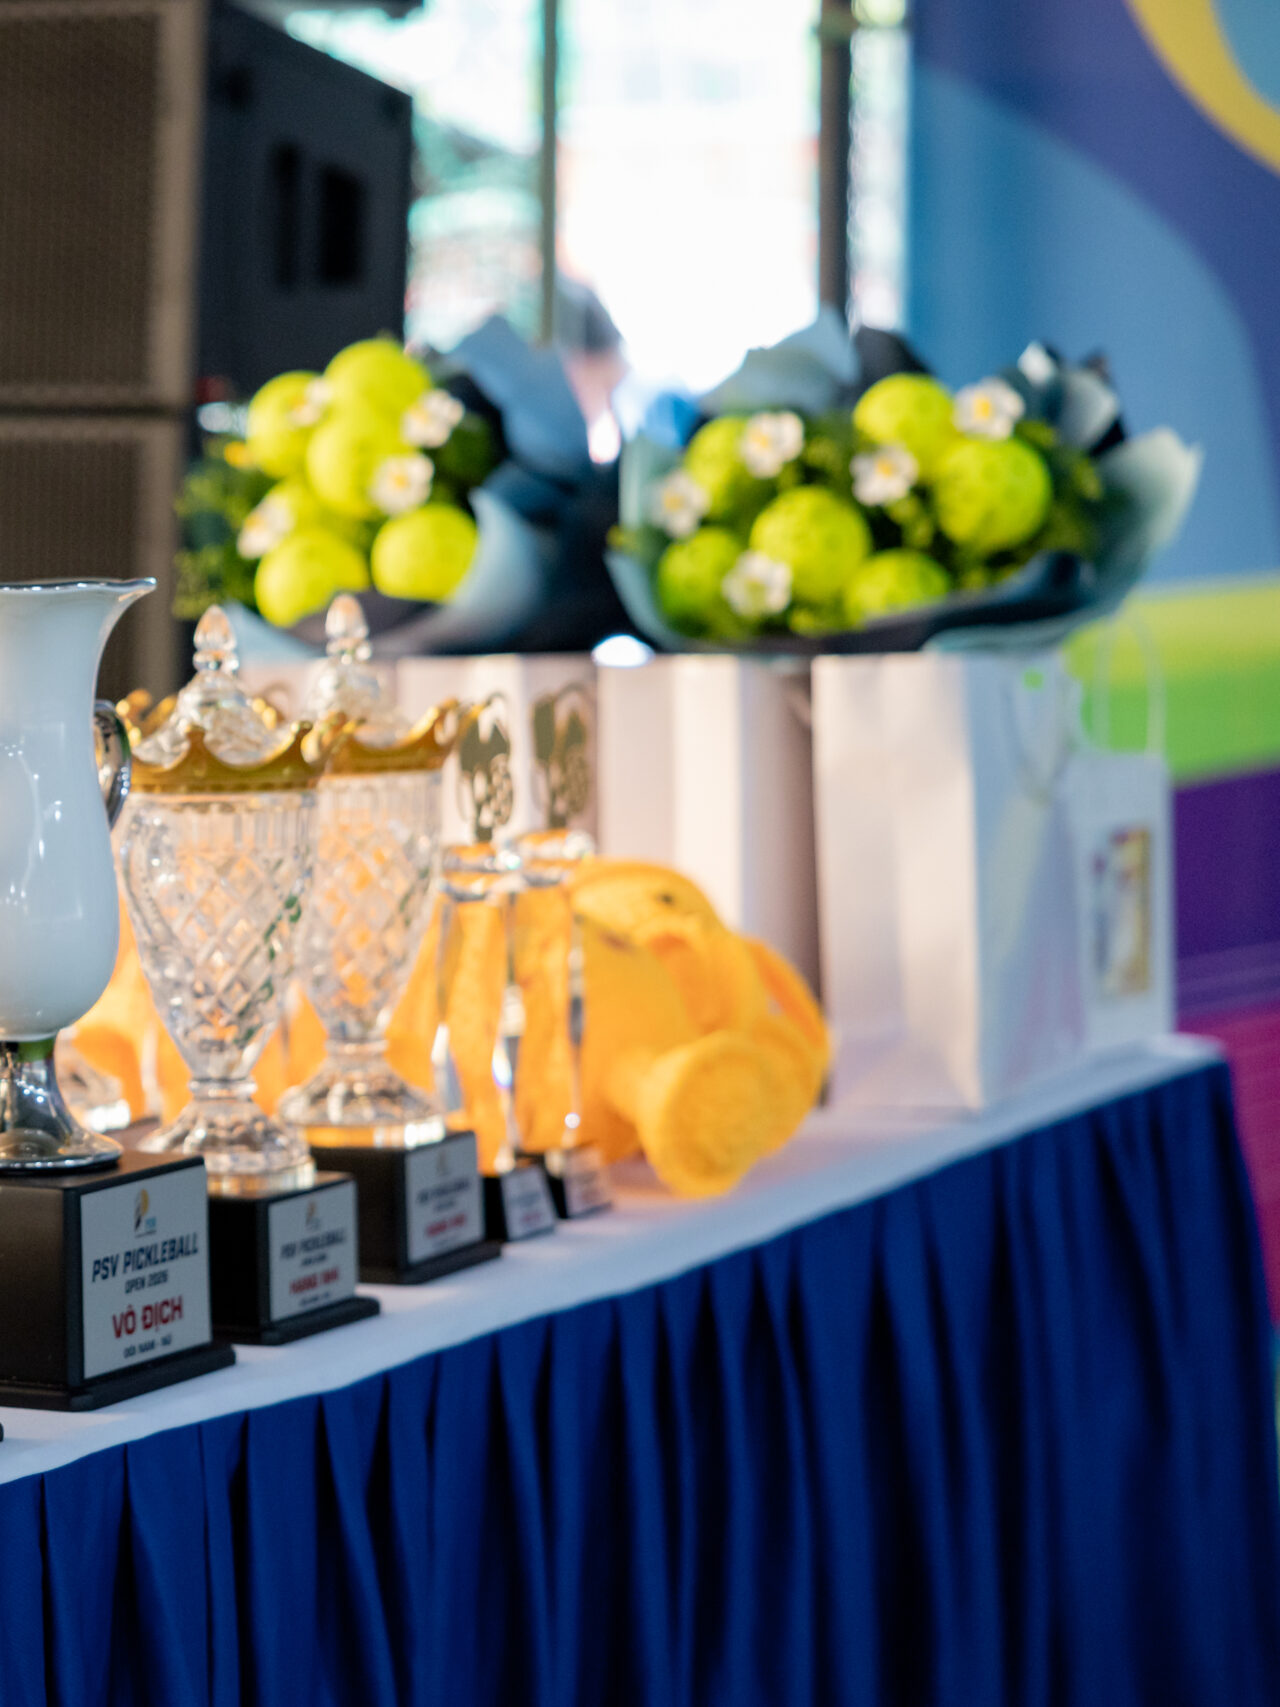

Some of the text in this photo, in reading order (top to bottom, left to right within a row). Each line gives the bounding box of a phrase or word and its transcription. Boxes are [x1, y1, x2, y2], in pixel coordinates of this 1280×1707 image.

[92, 1232, 199, 1283] PSV PICKLEBALL
[125, 1276, 146, 1294] OPEN
[112, 1295, 184, 1339] VÔ ĐỊCH
